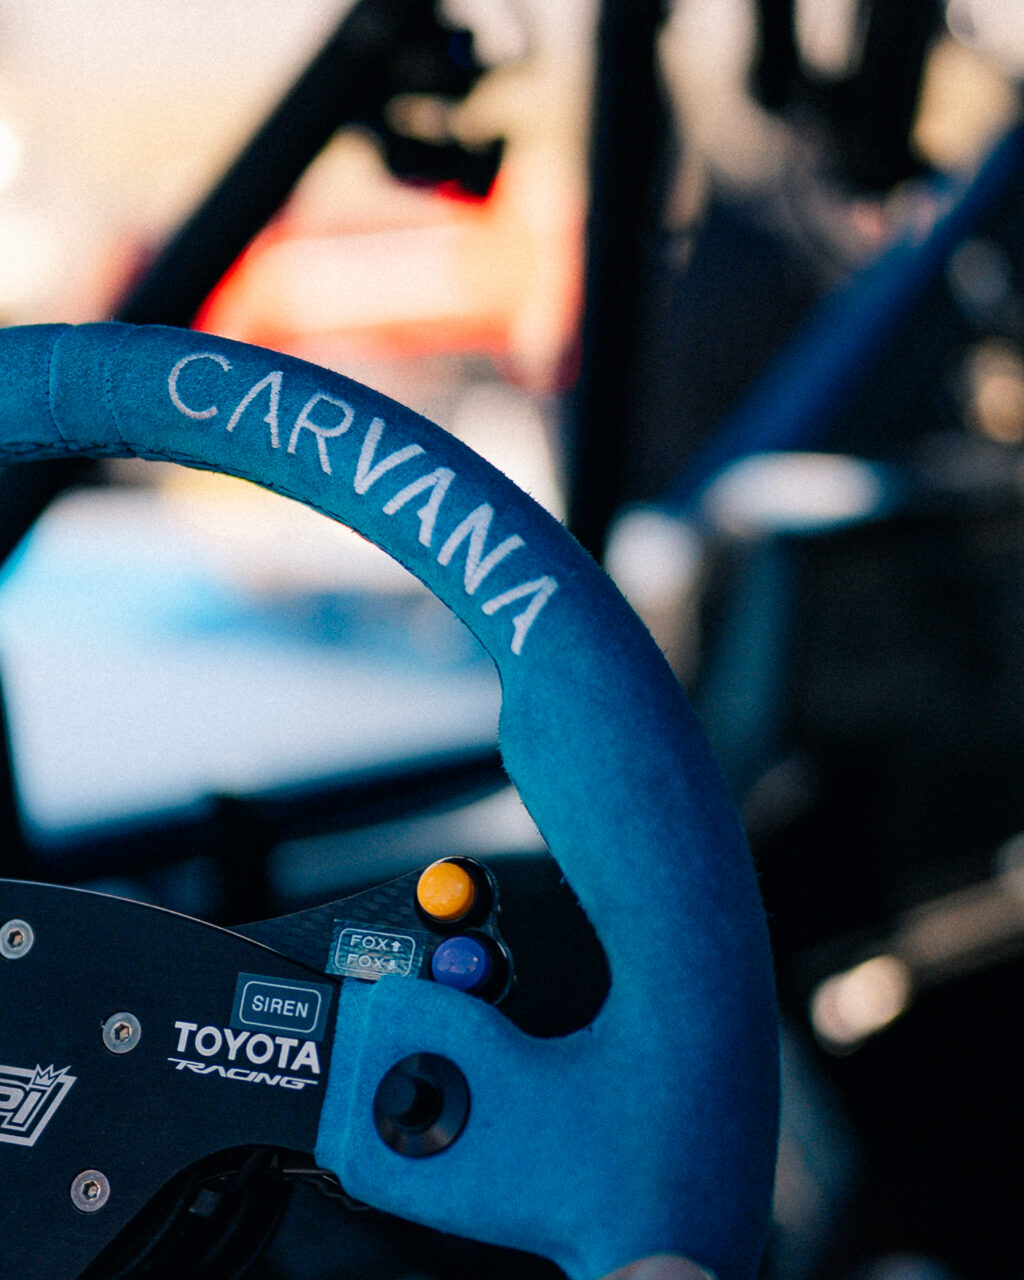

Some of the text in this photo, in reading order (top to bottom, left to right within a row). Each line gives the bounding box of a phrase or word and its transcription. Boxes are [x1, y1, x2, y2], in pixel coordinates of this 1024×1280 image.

[168, 352, 558, 656] CARVANA
[350, 933, 390, 952] FOX
[346, 953, 387, 970] FOX
[251, 995, 309, 1018] SIREN
[174, 1020, 321, 1075] TOYOTA
[167, 1057, 319, 1091] RACING
